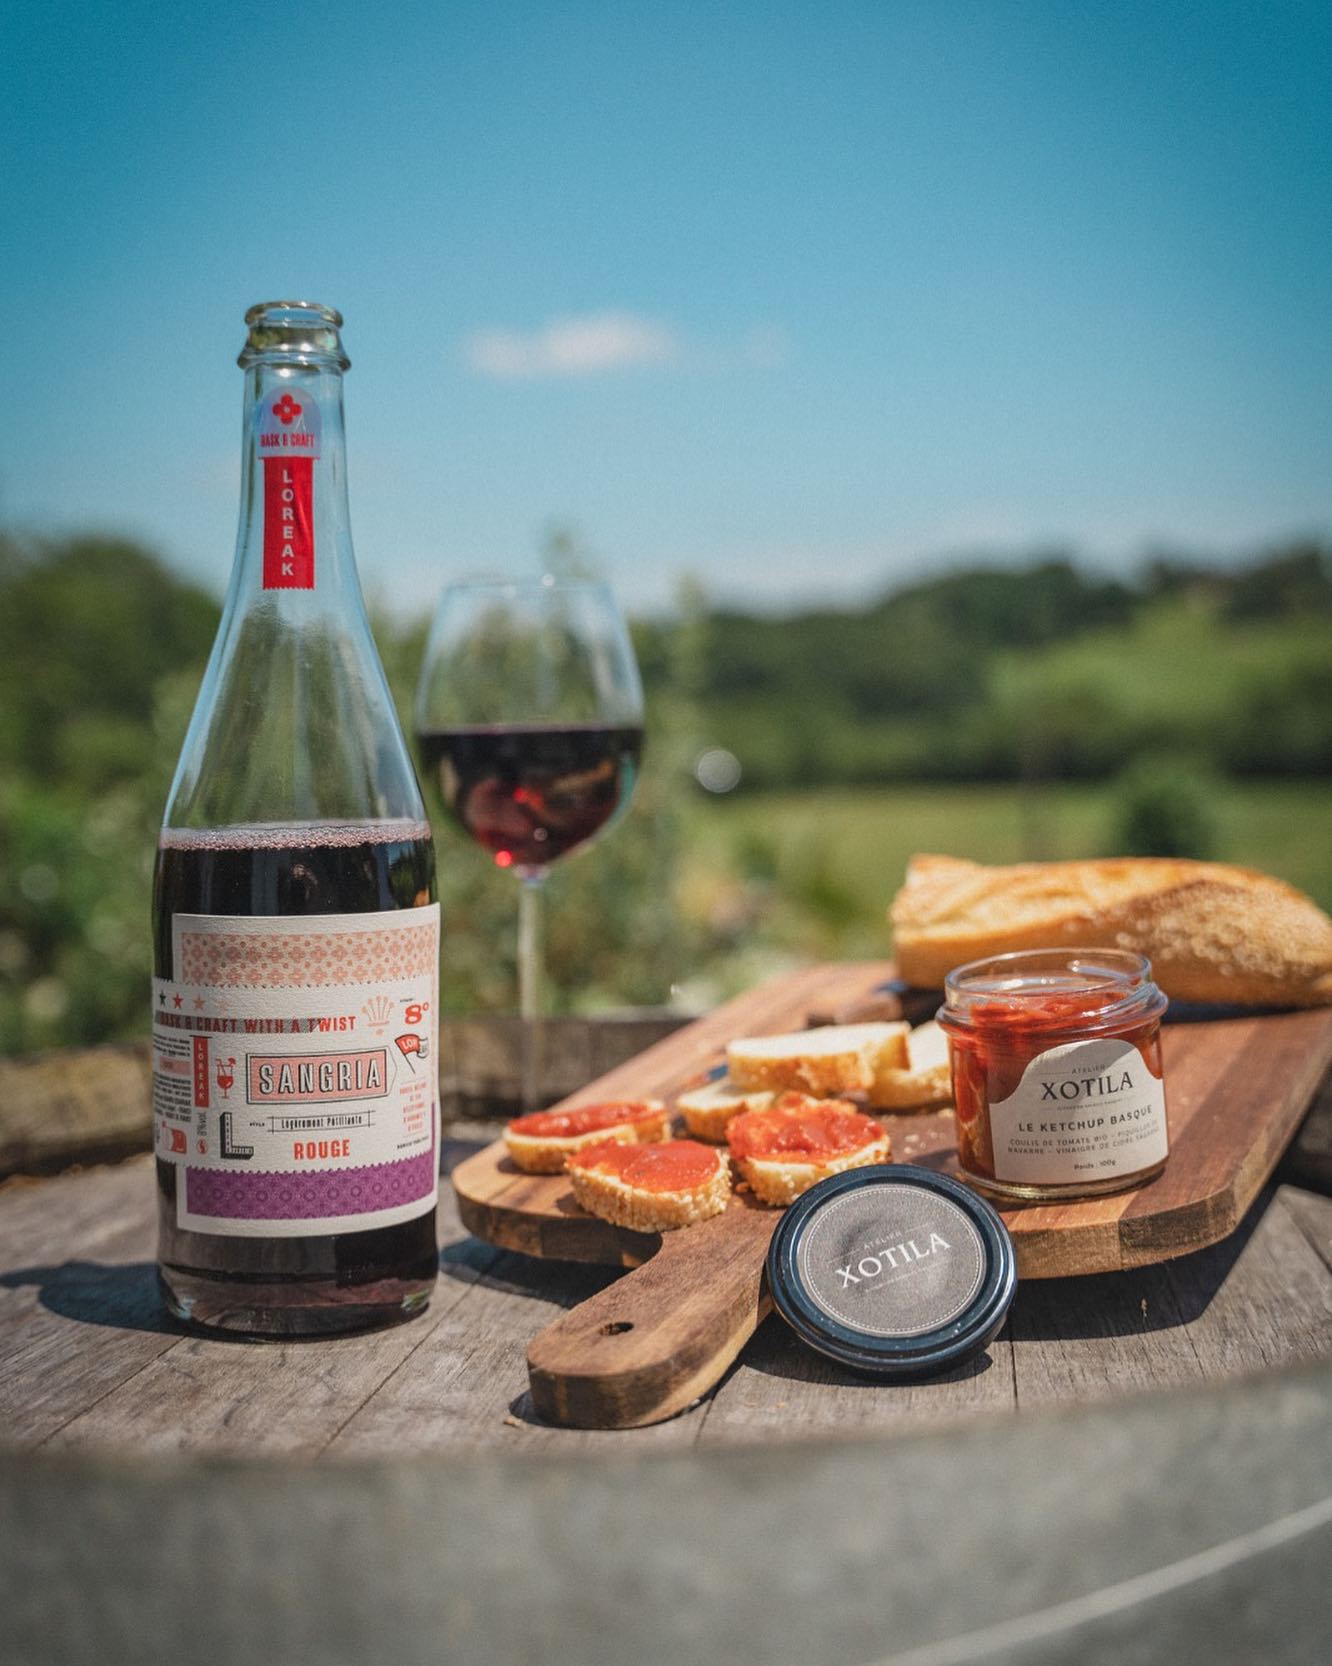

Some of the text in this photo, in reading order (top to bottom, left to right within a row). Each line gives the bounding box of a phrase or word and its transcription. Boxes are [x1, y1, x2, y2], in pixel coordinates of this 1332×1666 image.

[260, 433, 280, 447] BASK
[290, 433, 315, 447] CRAFT
[281, 469, 295, 577] LOREAK
[196, 1017, 237, 1033] CRAFT
[243, 1018, 284, 1034] WITH
[290, 1018, 303, 1034] A
[307, 1015, 357, 1033] TWIST
[258, 1058, 382, 1096] SANGRIA
[1041, 1070, 1134, 1101] XOTILA
[1018, 1122, 1033, 1133] LE
[1040, 1118, 1105, 1133] KETCHUP
[1110, 1104, 1153, 1126] BASQUE
[293, 1138, 351, 1161] ROUGE
[1008, 1146, 1044, 1155] NAVARRE
[1056, 1144, 1096, 1155] VINAIGRE
[1099, 1142, 1109, 1150] DE
[1009, 1138, 1040, 1147] COULIS
[1042, 1139, 1053, 1147] DE
[1057, 1136, 1091, 1147] TOMATE
[1094, 1134, 1109, 1143] BIO
[834, 1231, 953, 1290] XOTILA
